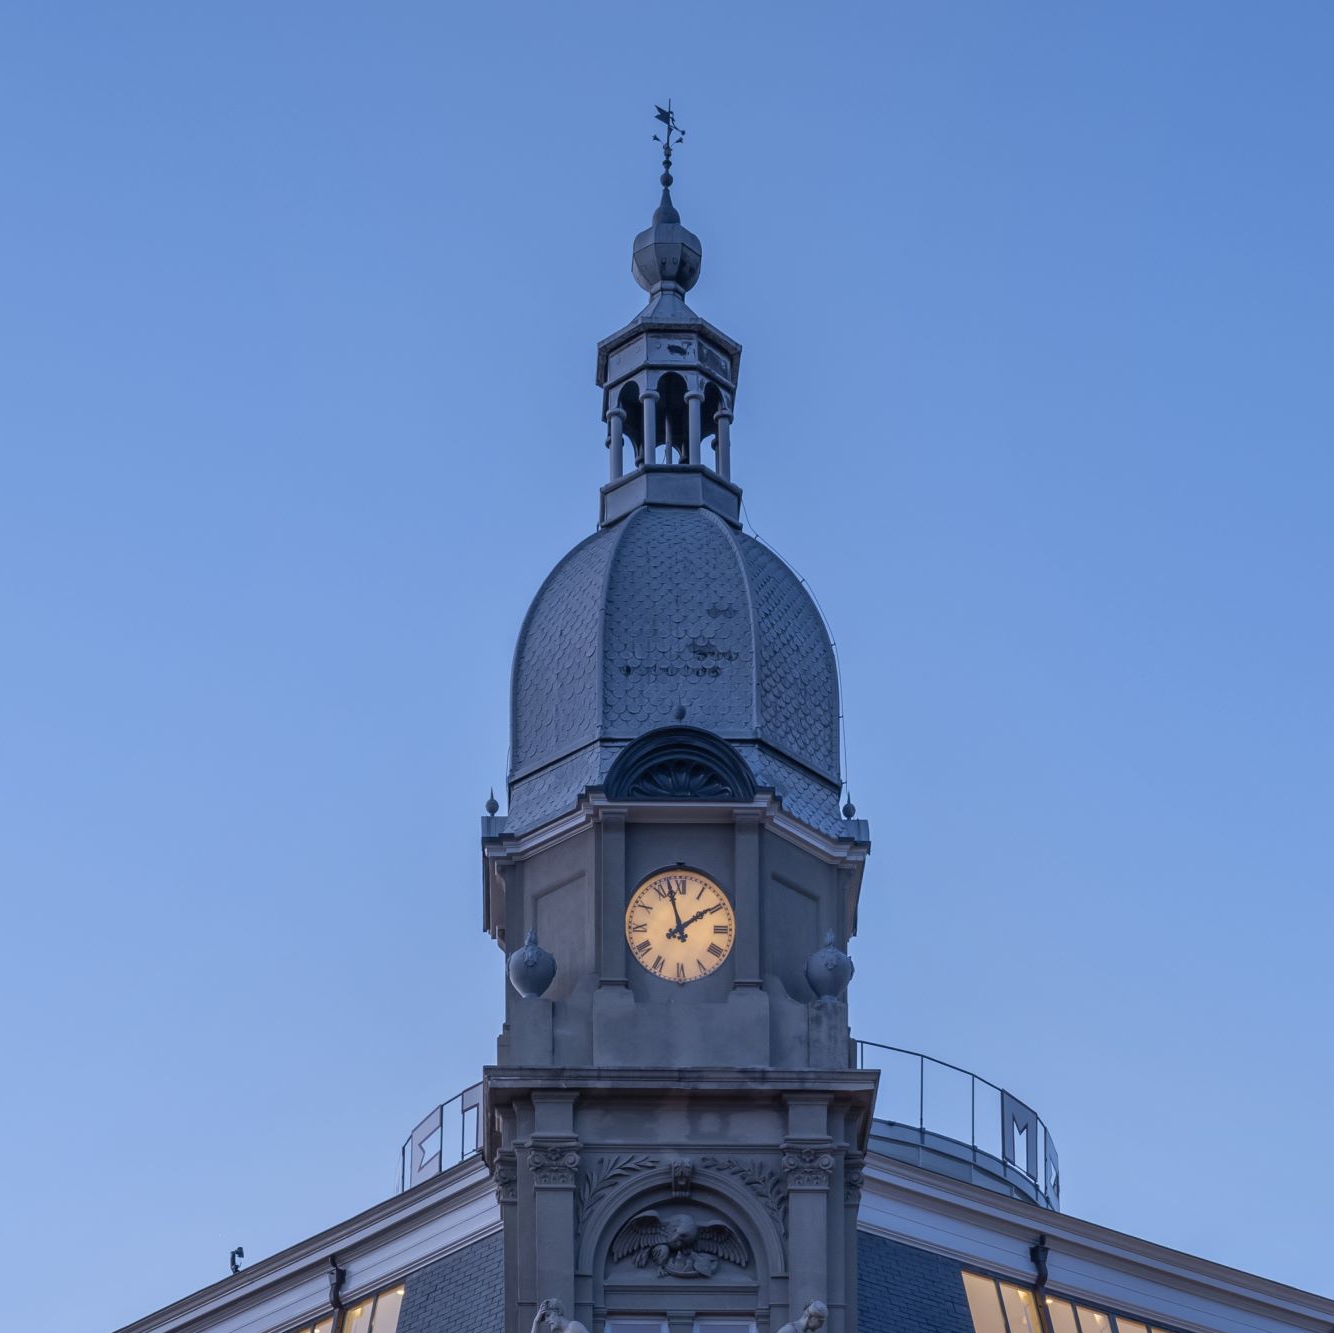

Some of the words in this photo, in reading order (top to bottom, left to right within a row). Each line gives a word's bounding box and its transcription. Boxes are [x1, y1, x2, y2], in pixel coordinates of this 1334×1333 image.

[675, 880, 687, 895] XII
[696, 887, 705, 900] I
[637, 900, 654, 914] X
[714, 925, 728, 934] III
[636, 940, 652, 957] VIII
[652, 955, 666, 971] VII
[697, 959, 707, 972] V
[677, 963, 686, 978] VI
